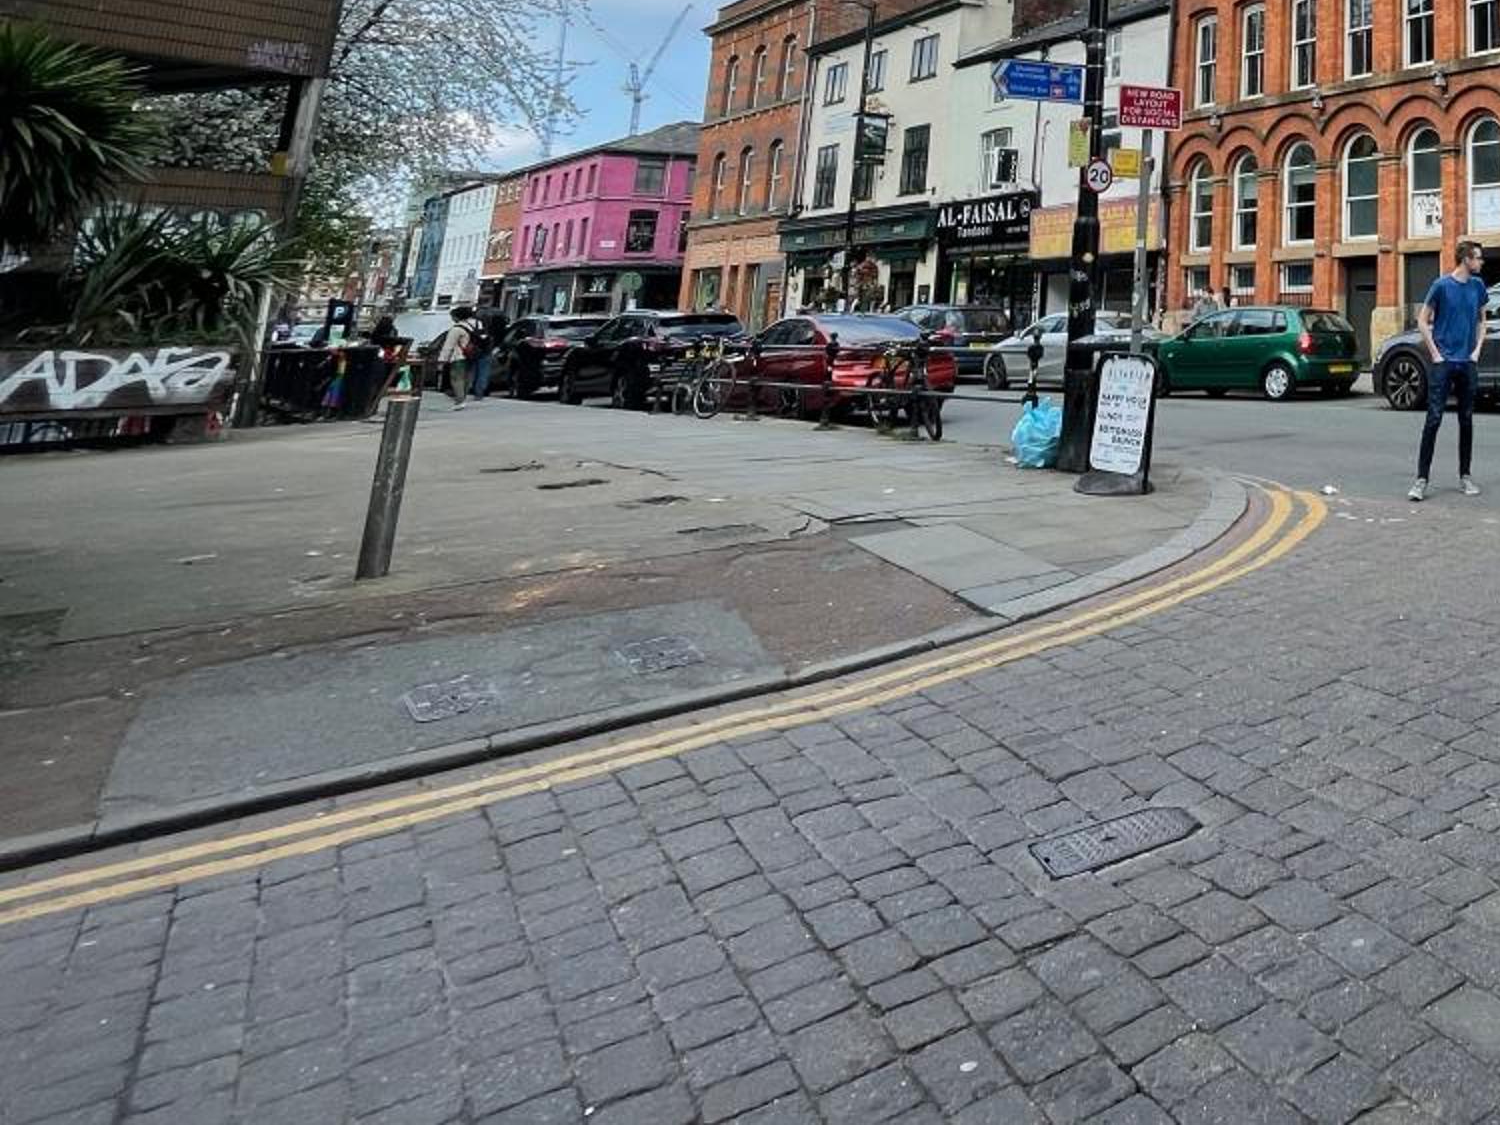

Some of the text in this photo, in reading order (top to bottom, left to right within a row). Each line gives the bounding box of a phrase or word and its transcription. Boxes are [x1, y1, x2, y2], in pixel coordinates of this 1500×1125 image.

[1127, 89, 1175, 100] NEW ROAD
[1133, 98, 1168, 108] LAYOUT
[1123, 106, 1177, 118] FOR SOCIAL
[1121, 115, 1178, 127] DISTANCING
[1089, 167, 1110, 184] 20
